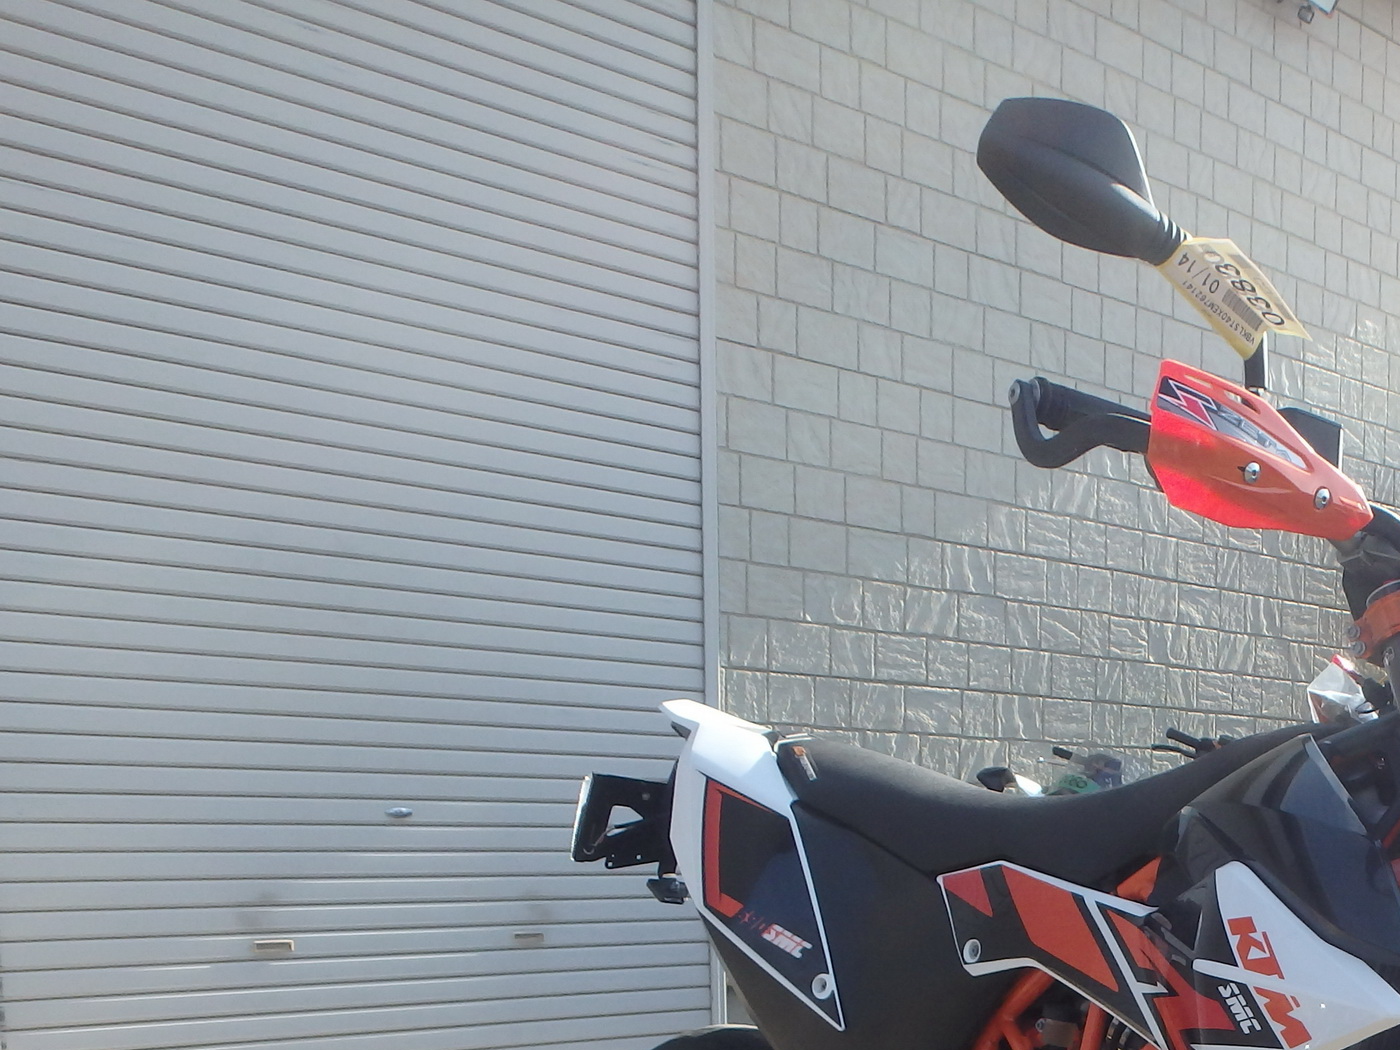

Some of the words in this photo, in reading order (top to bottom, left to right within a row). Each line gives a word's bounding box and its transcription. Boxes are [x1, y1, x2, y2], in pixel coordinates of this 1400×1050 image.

[1178, 252, 1220, 294] 01/14
[761, 922, 813, 959] SMC
[1227, 916, 1312, 1049] KTM
[1217, 982, 1262, 1035] SMC
